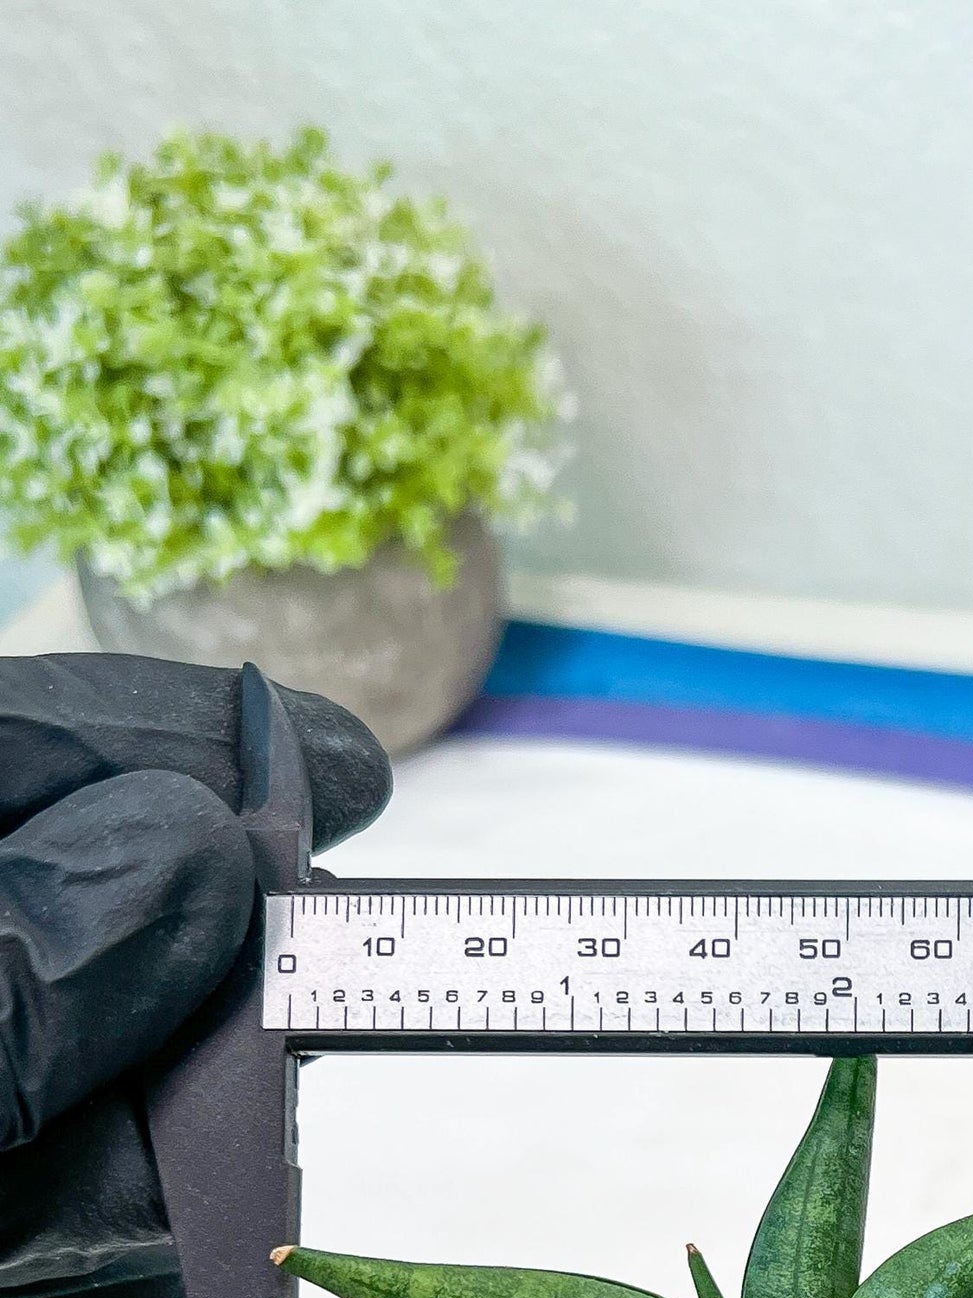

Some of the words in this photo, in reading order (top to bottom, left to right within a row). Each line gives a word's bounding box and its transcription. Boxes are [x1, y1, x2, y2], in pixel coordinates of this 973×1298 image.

[278, 953, 297, 975] 0
[363, 937, 396, 957] 10
[464, 937, 508, 957] 20
[577, 937, 621, 958] 30
[689, 938, 731, 959] 40
[800, 938, 841, 959] 50
[910, 939, 953, 960] 60
[311, 990, 316, 1002] 1
[333, 990, 345, 1002] 2
[361, 990, 374, 1001] 3
[389, 990, 401, 1002] 4
[418, 990, 430, 1002] 5
[446, 990, 458, 1002] 6
[477, 990, 488, 1002] 7
[502, 990, 516, 1002] 8
[531, 990, 544, 1004] 9
[560, 976, 569, 995] 1
[594, 992, 599, 1004] 1
[616, 991, 629, 1004] 2
[644, 991, 657, 1003] 3
[672, 992, 684, 1004] 4
[701, 992, 712, 1004] 5
[729, 992, 742, 1004] 6
[760, 992, 770, 1004] 7
[785, 992, 799, 1004] 8
[814, 992, 827, 1005] 9
[832, 977, 852, 997] 2
[877, 993, 882, 1004] 1
[899, 992, 912, 1005] 2
[927, 992, 939, 1004] 3
[955, 992, 967, 1006] 4
